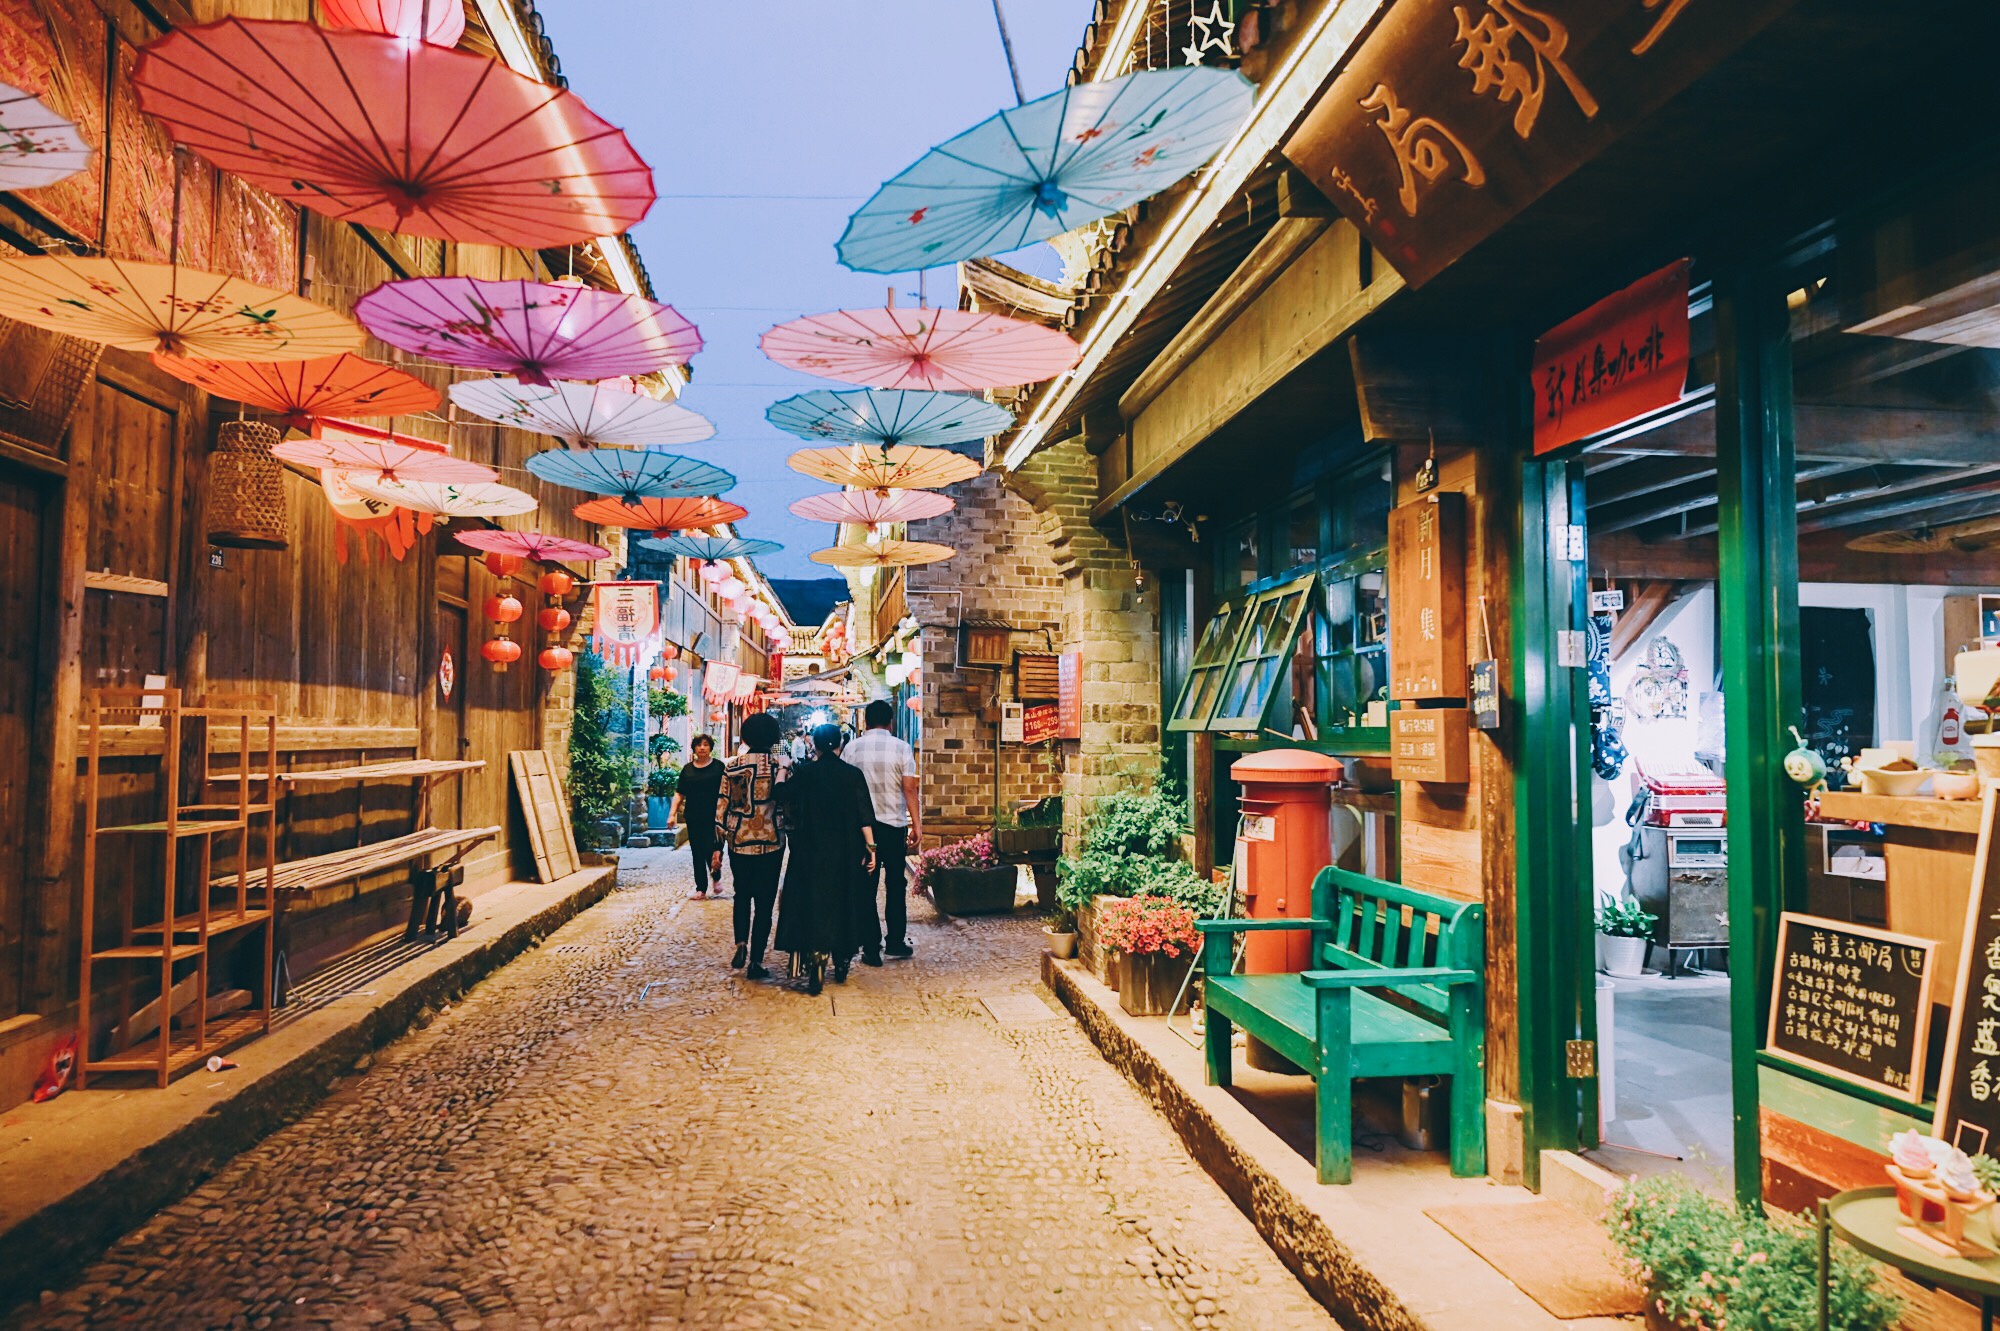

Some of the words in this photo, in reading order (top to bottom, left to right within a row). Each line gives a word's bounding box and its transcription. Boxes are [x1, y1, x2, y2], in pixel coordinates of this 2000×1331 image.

[1811, 931, 1893, 972] 前童古邮局
